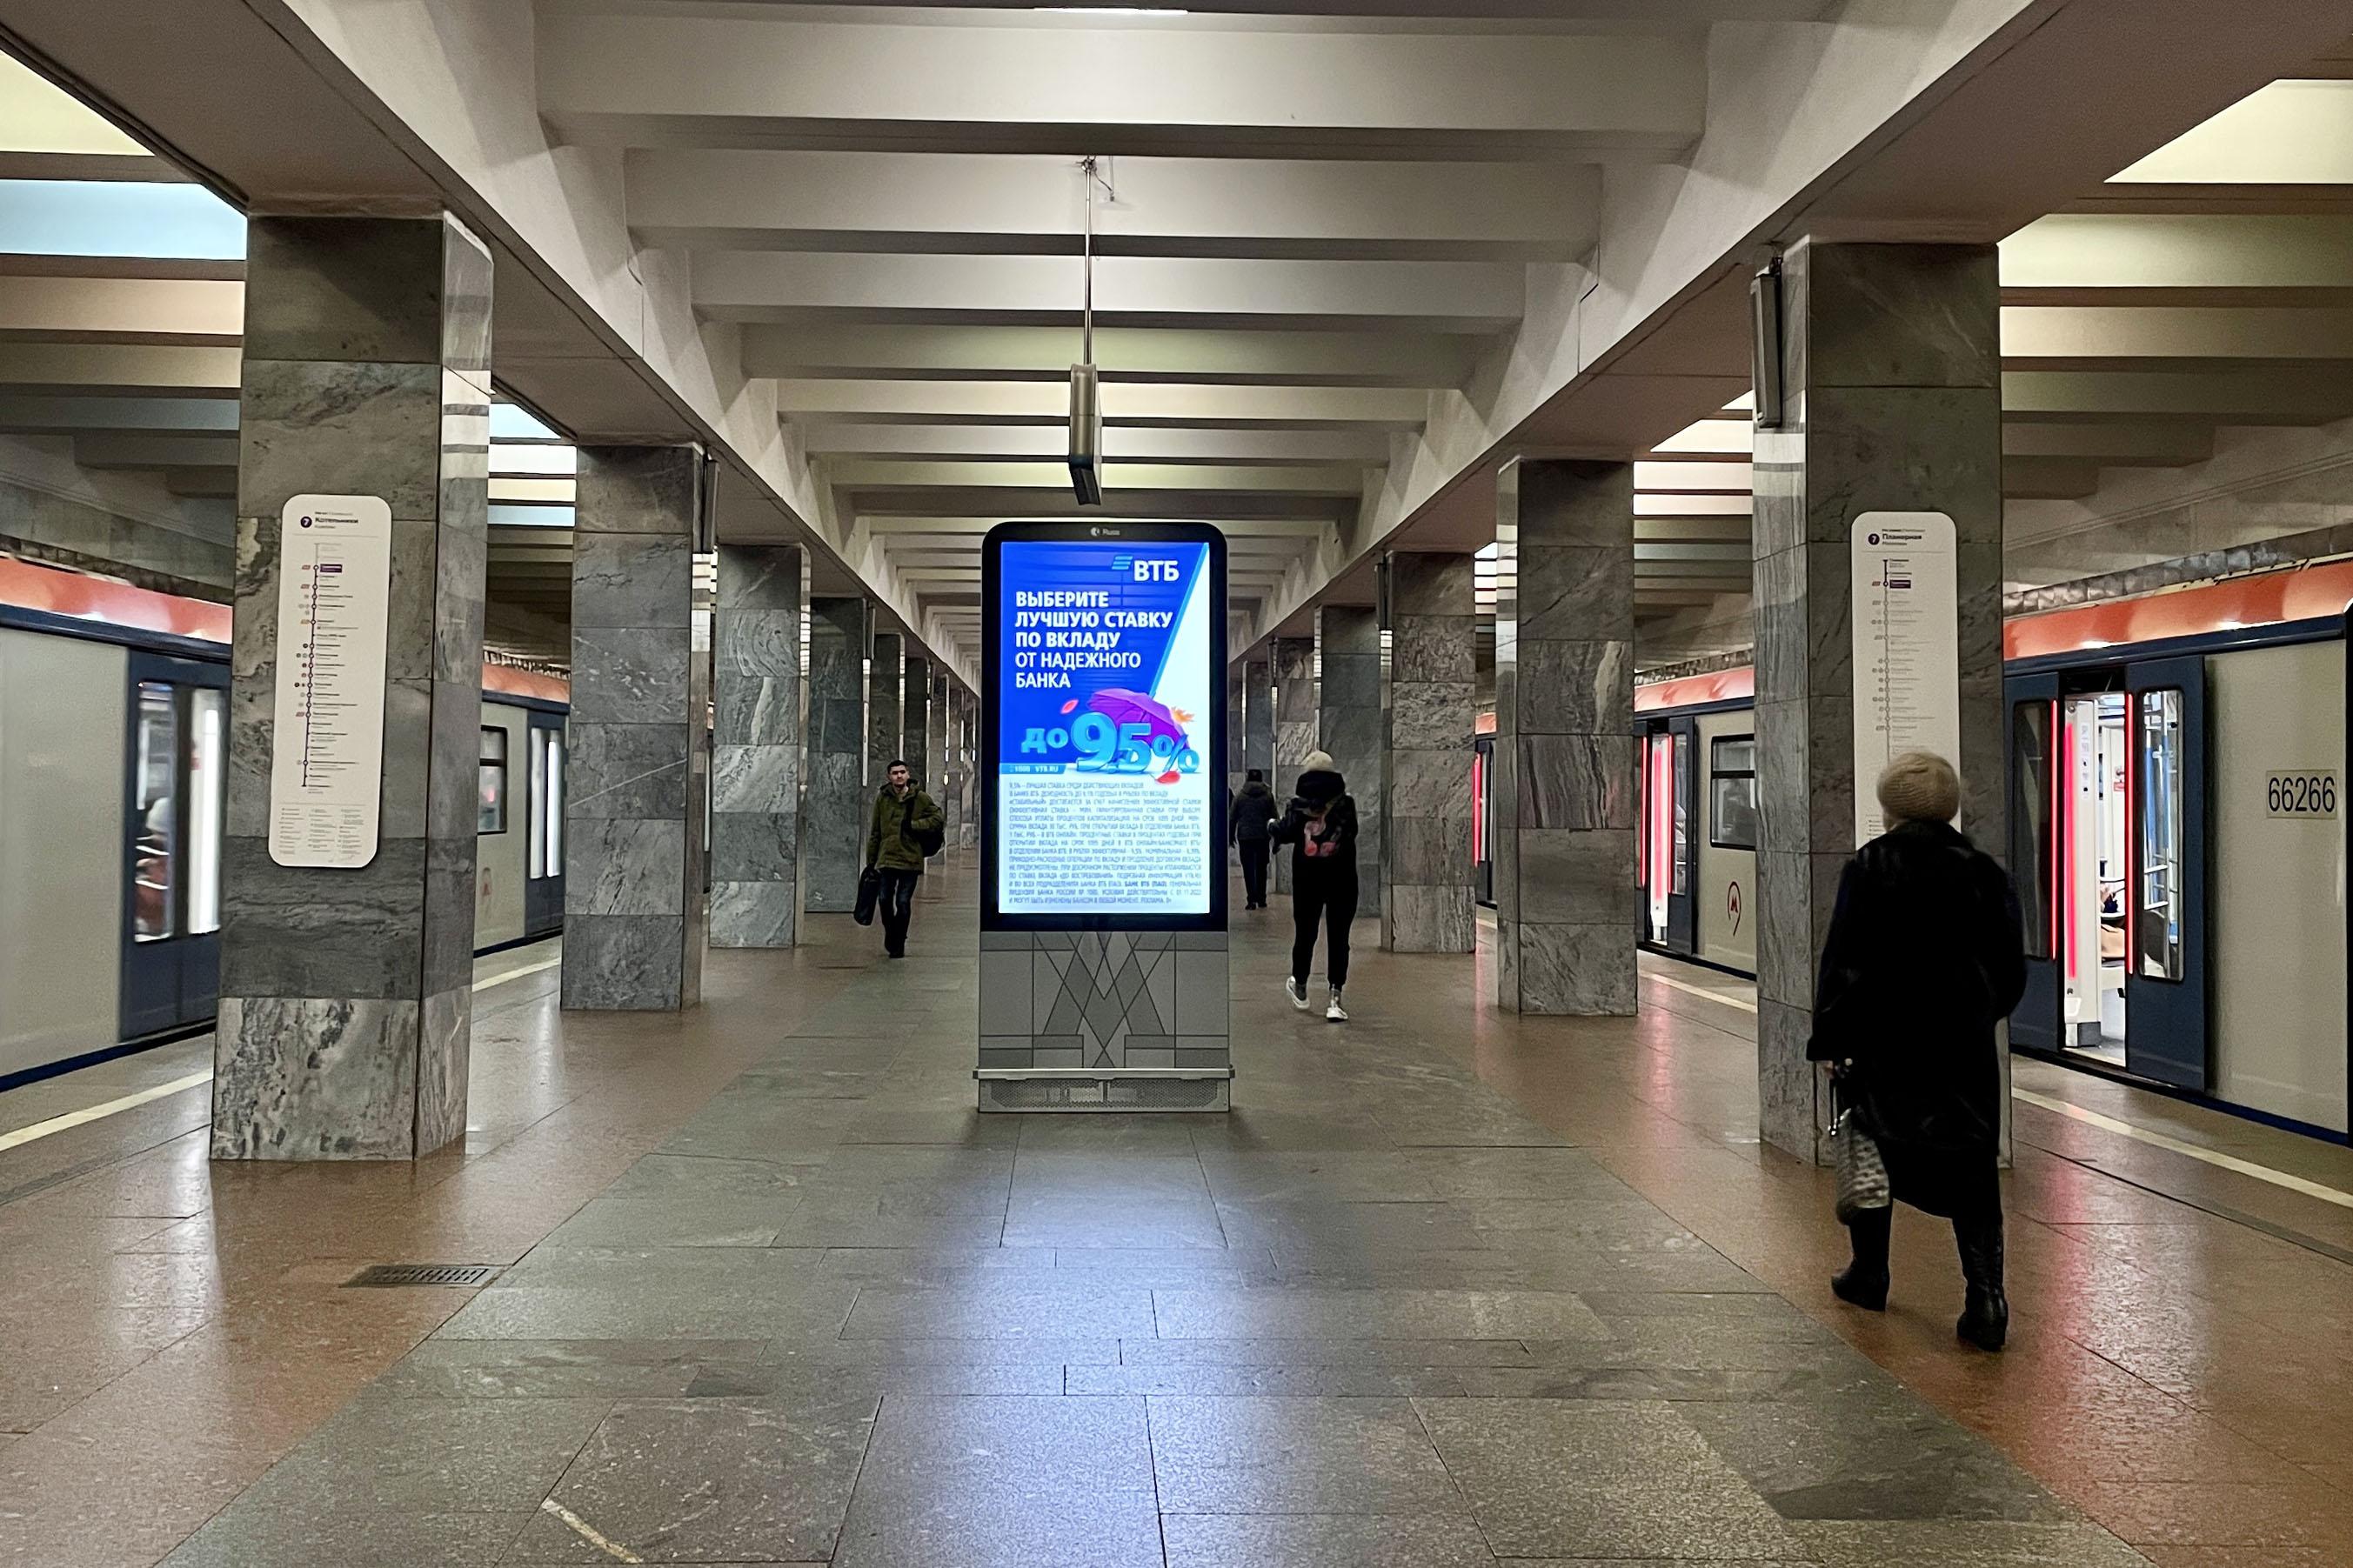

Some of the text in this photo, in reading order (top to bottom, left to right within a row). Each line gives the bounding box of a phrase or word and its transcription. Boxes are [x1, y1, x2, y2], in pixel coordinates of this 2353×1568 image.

[1133, 559, 1180, 582] ВТБ
[1015, 591, 1109, 608] ВЫБЕРИТЕ
[1014, 611, 1173, 628] ЛУЧШУЮ СТАВКУ
[1015, 631, 1121, 651] ПО ВКЛАДУ
[1015, 651, 1141, 671] ОТ НАДЕЖНОГО
[1015, 672, 1072, 689] БАНКА
[2269, 777, 2335, 812] 66266
